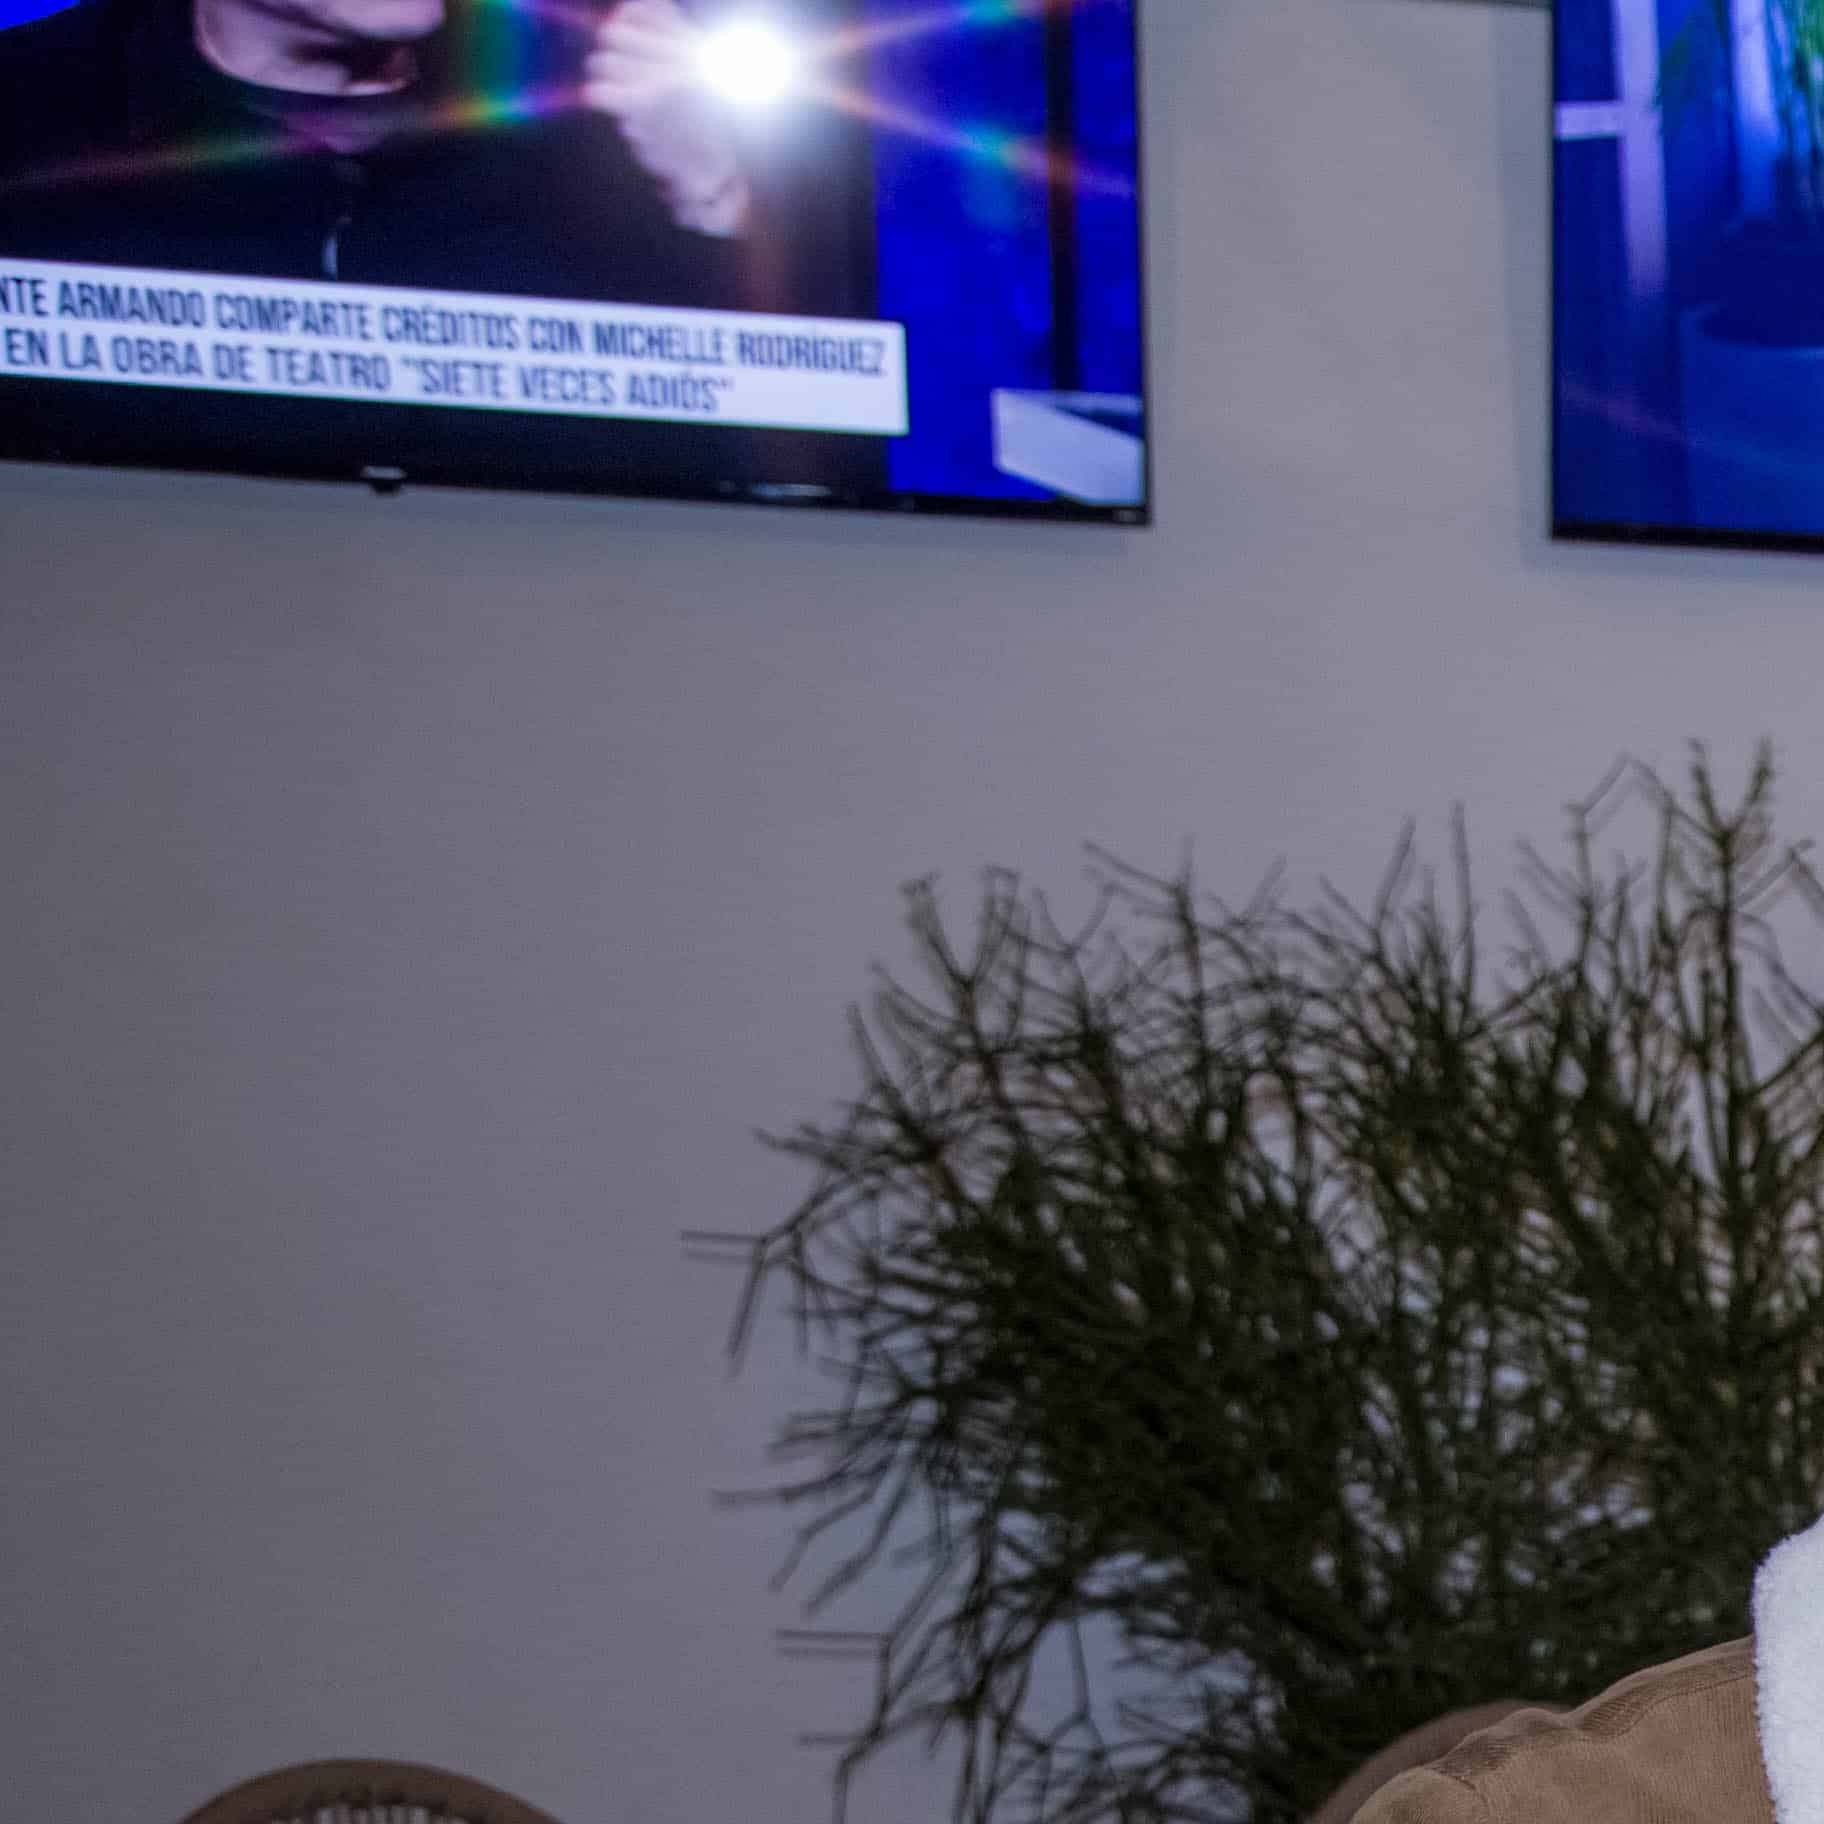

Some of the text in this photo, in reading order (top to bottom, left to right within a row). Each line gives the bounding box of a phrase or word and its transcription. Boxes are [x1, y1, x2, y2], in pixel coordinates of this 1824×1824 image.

[58, 279, 206, 329] ARMANDO
[213, 292, 375, 344] COMPARTE
[381, 301, 519, 352] CRÉDITOS
[528, 317, 584, 355] CON
[594, 319, 725, 366] MICHELLE
[5, 326, 50, 368] EN
[61, 331, 101, 371] LA
[112, 335, 203, 377] OBRA
[213, 342, 259, 383] DE
[264, 346, 393, 393] TEATRO
[399, 355, 510, 400] "SIETE
[518, 363, 617, 407] VECES
